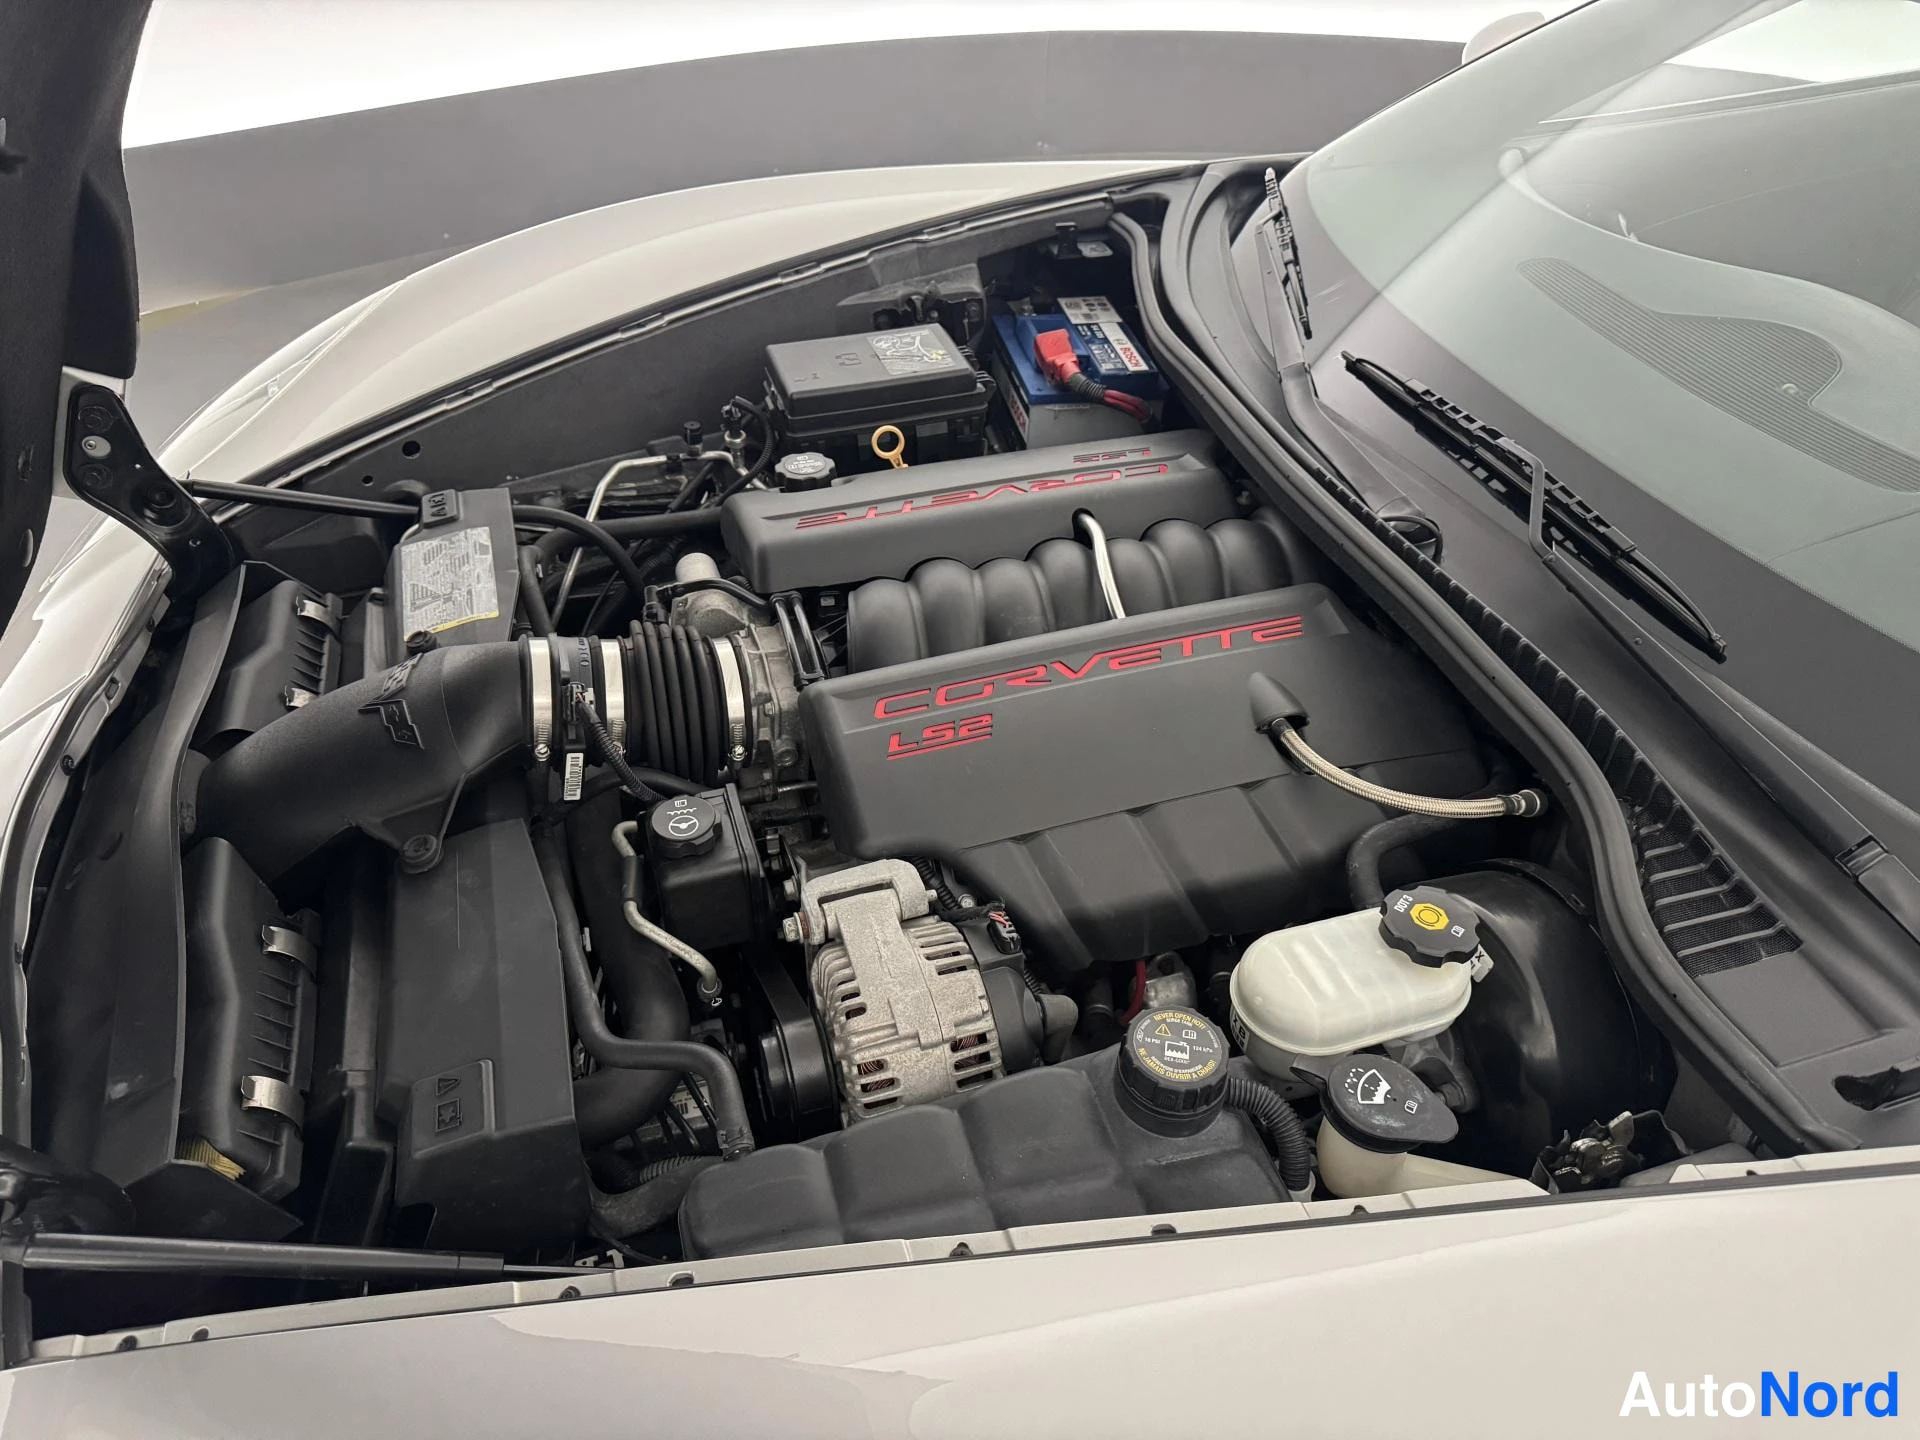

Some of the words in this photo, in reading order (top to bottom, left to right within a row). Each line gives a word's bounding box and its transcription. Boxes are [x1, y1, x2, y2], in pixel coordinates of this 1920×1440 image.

[1119, 347, 1143, 368] BOSCH
[795, 463, 1169, 530] CORVETTE
[873, 615, 1304, 719] CORVETTE
[887, 713, 993, 755] LS2
[1393, 897, 1410, 913] DOT
[1153, 1012, 1174, 1021] NEVER
[1174, 1012, 1192, 1022] OPEN
[1143, 1056, 1165, 1074] JAMAIS
[1165, 1071, 1191, 1080] OUVRIR
